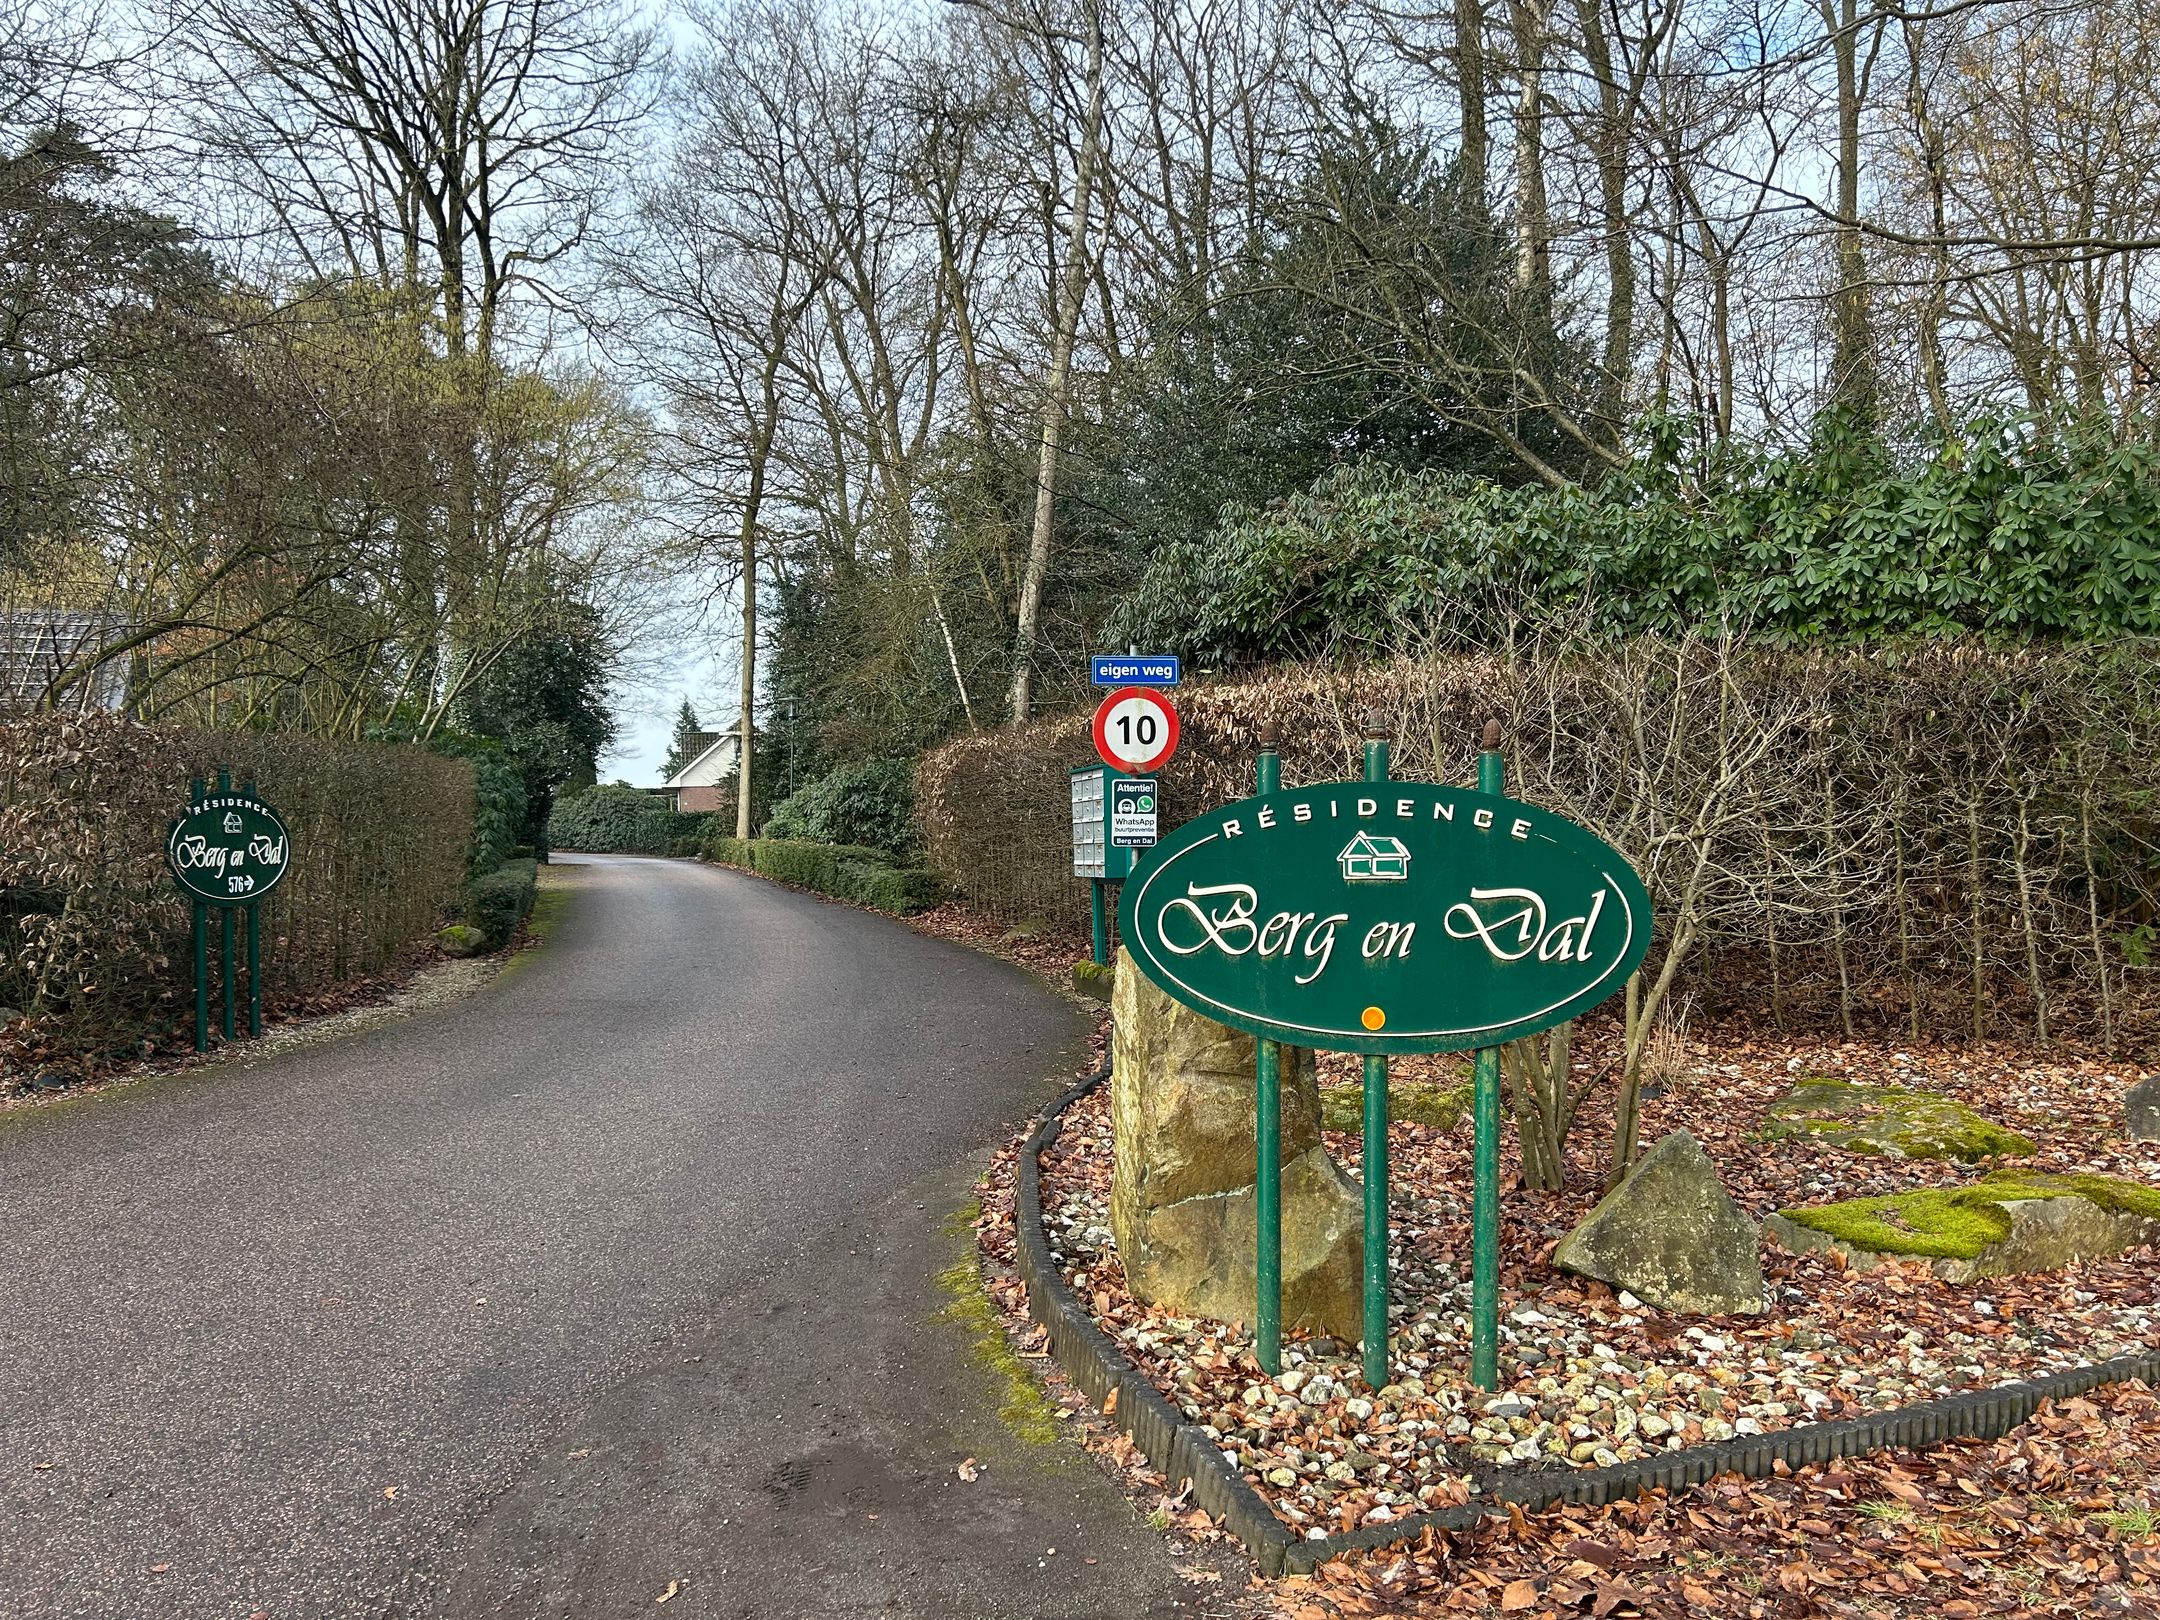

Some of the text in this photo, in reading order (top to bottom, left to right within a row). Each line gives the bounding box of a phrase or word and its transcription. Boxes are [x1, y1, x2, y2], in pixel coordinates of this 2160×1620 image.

[1100, 663, 1173, 678] eigen weg
[1116, 715, 1157, 745] 10
[1117, 783, 1153, 792] Attentie!
[193, 798, 268, 816] RÉSIDENCE
[1115, 818, 1155, 826] WhatsApp
[1223, 798, 1533, 839] RÉSIDENCE
[177, 833, 283, 878] Berg en Dal
[228, 876, 244, 893] 576
[1157, 881, 1606, 984] Berg en Dal
